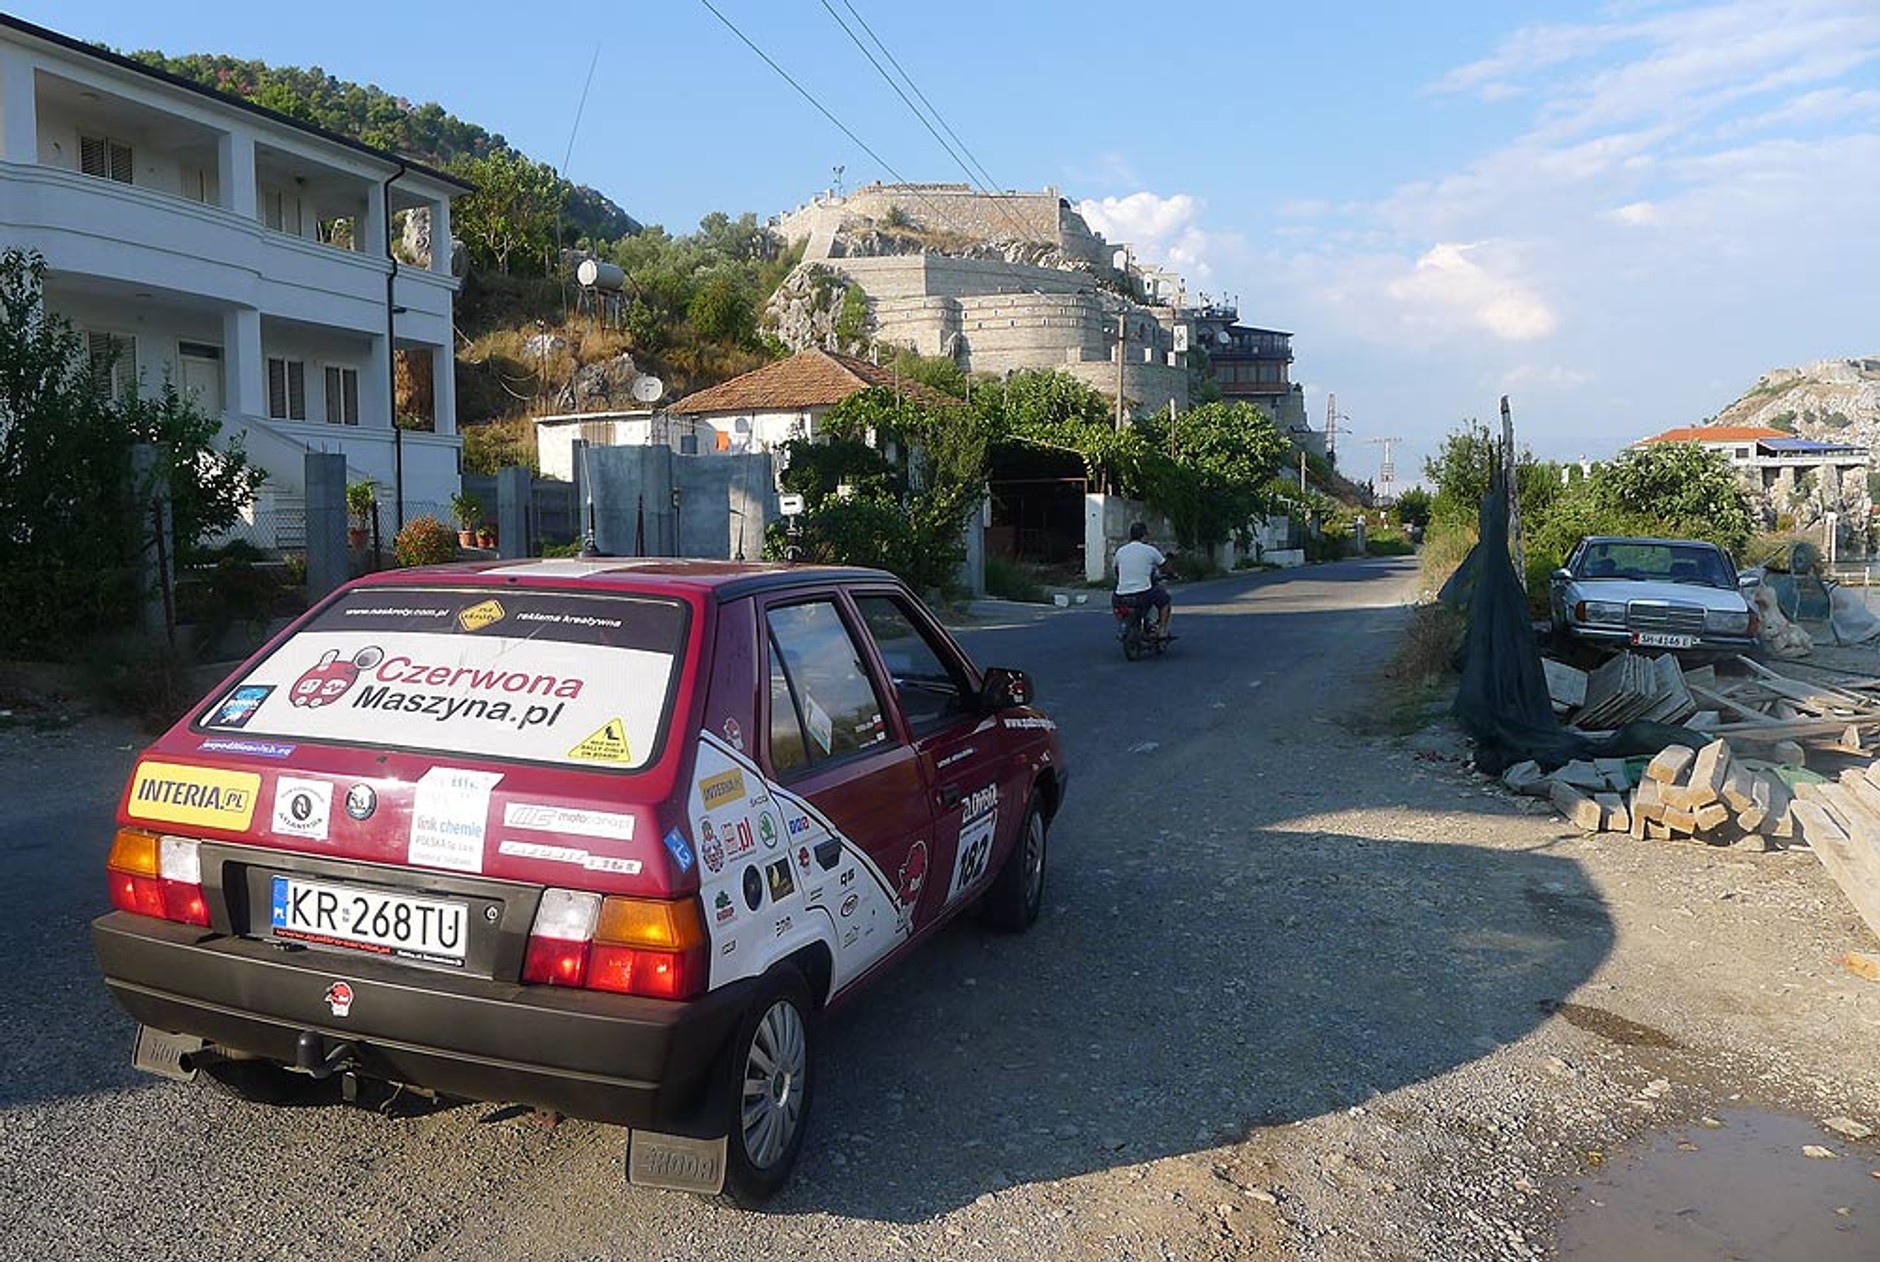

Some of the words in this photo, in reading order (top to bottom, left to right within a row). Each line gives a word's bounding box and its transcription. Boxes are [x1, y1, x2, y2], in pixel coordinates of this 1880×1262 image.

[517, 612, 561, 623] reklama
[562, 615, 622, 628] kreatywna
[376, 656, 584, 699] Czerwona
[352, 685, 565, 729] Maszyna.pl
[440, 819, 482, 838] chemie
[956, 833, 989, 891] 182
[293, 887, 337, 931] KR
[351, 896, 459, 949] 268TU
